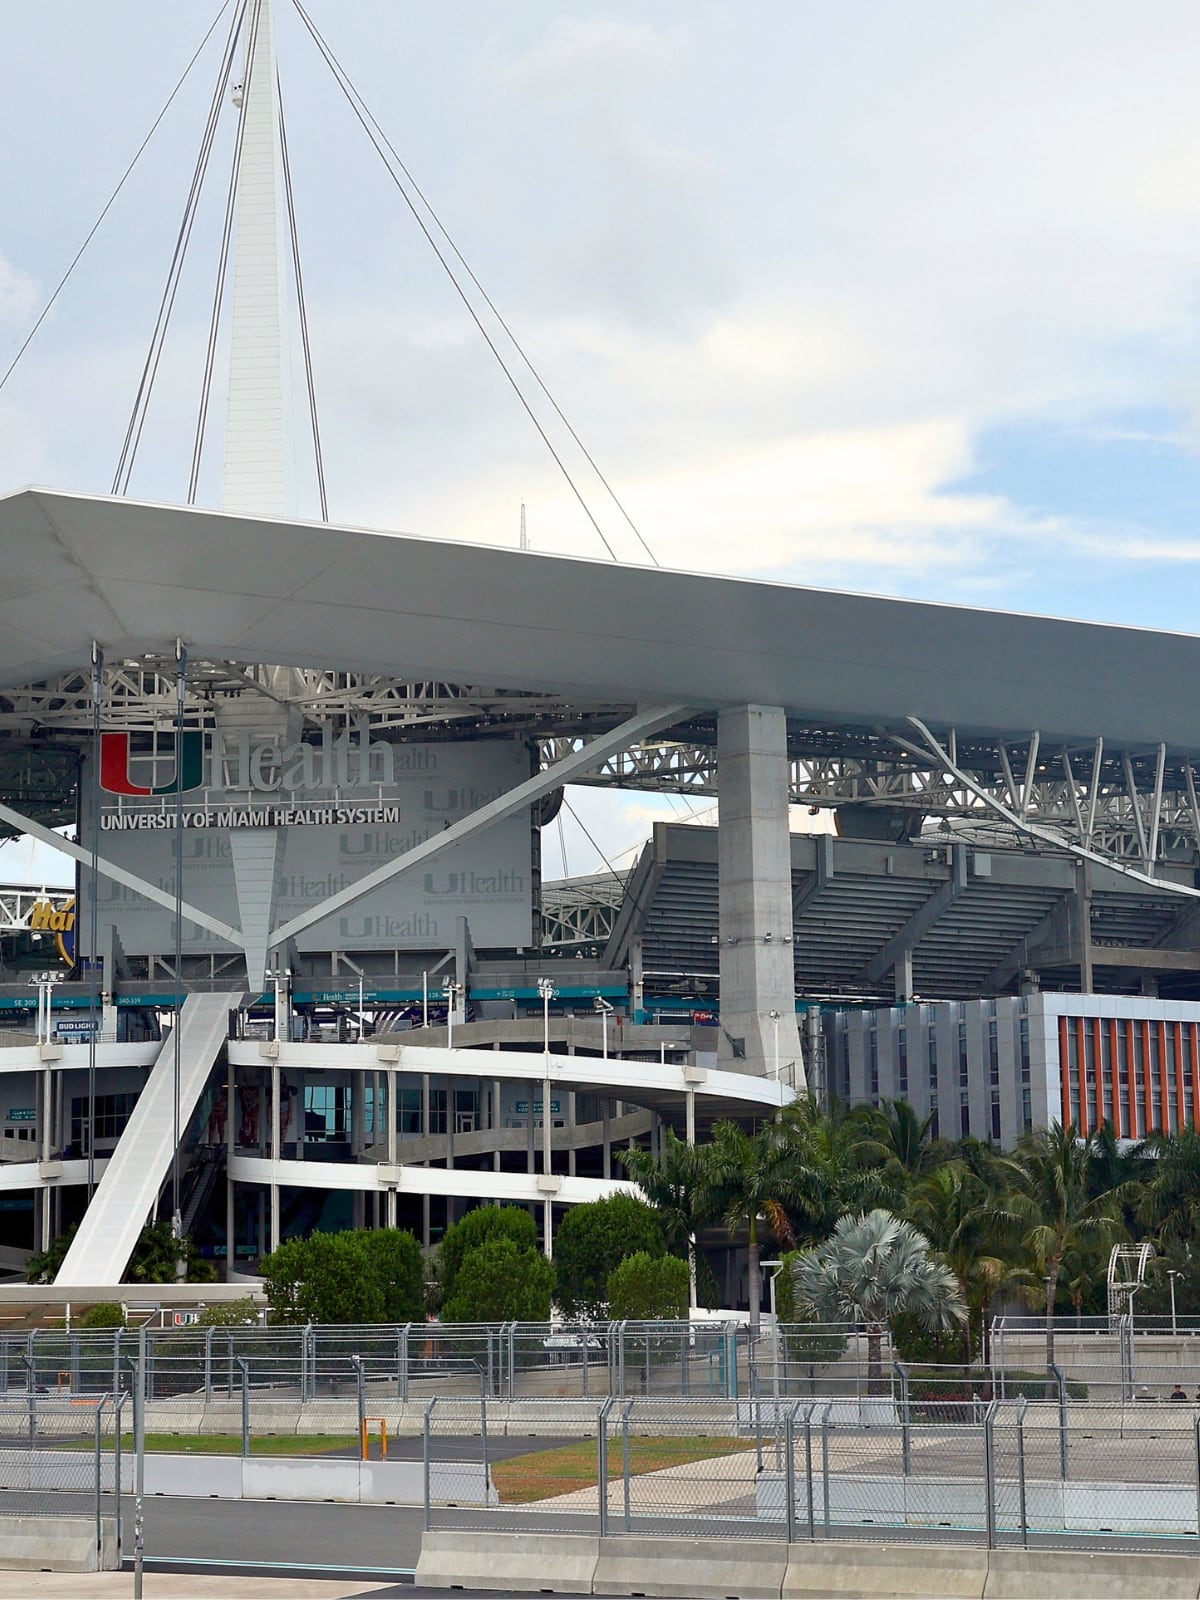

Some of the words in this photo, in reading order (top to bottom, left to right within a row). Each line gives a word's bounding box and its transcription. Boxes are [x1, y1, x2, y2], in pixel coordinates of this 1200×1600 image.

[100, 812, 193, 831] UNIVERSITY
[194, 811, 213, 828] OF
[217, 811, 269, 828] MIAMI
[274, 809, 332, 826] HEALTH
[337, 807, 399, 824] SYSTEM
[424, 868, 524, 894] UHealth
[31, 903, 76, 932] Har
[339, 912, 438, 938] UHealth
[14, 999, 23, 1007] SE
[24, 999, 37, 1007] 300
